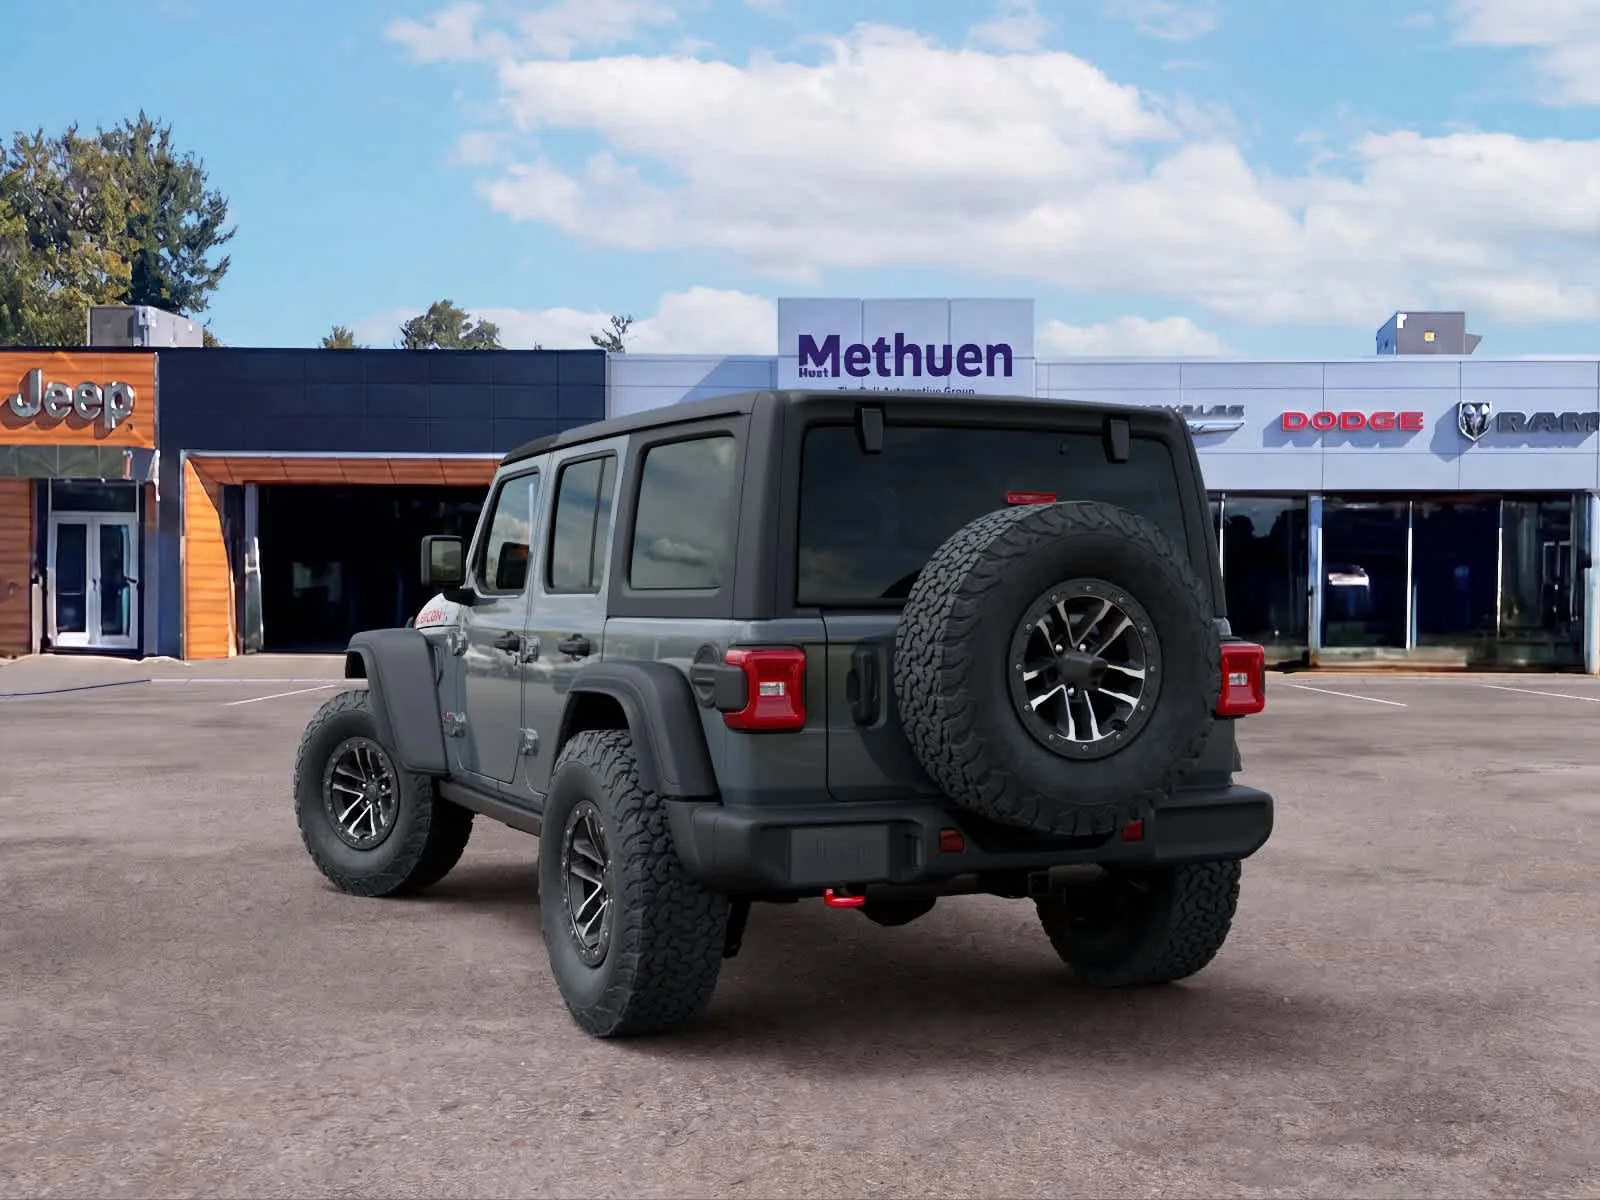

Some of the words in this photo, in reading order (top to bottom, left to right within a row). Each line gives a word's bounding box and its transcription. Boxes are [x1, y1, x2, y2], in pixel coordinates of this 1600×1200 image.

[798, 332, 1014, 378] Methuen
[8, 367, 137, 429] Jeep
[1281, 411, 1424, 432] DODGE
[1496, 411, 1600, 433] RAM
